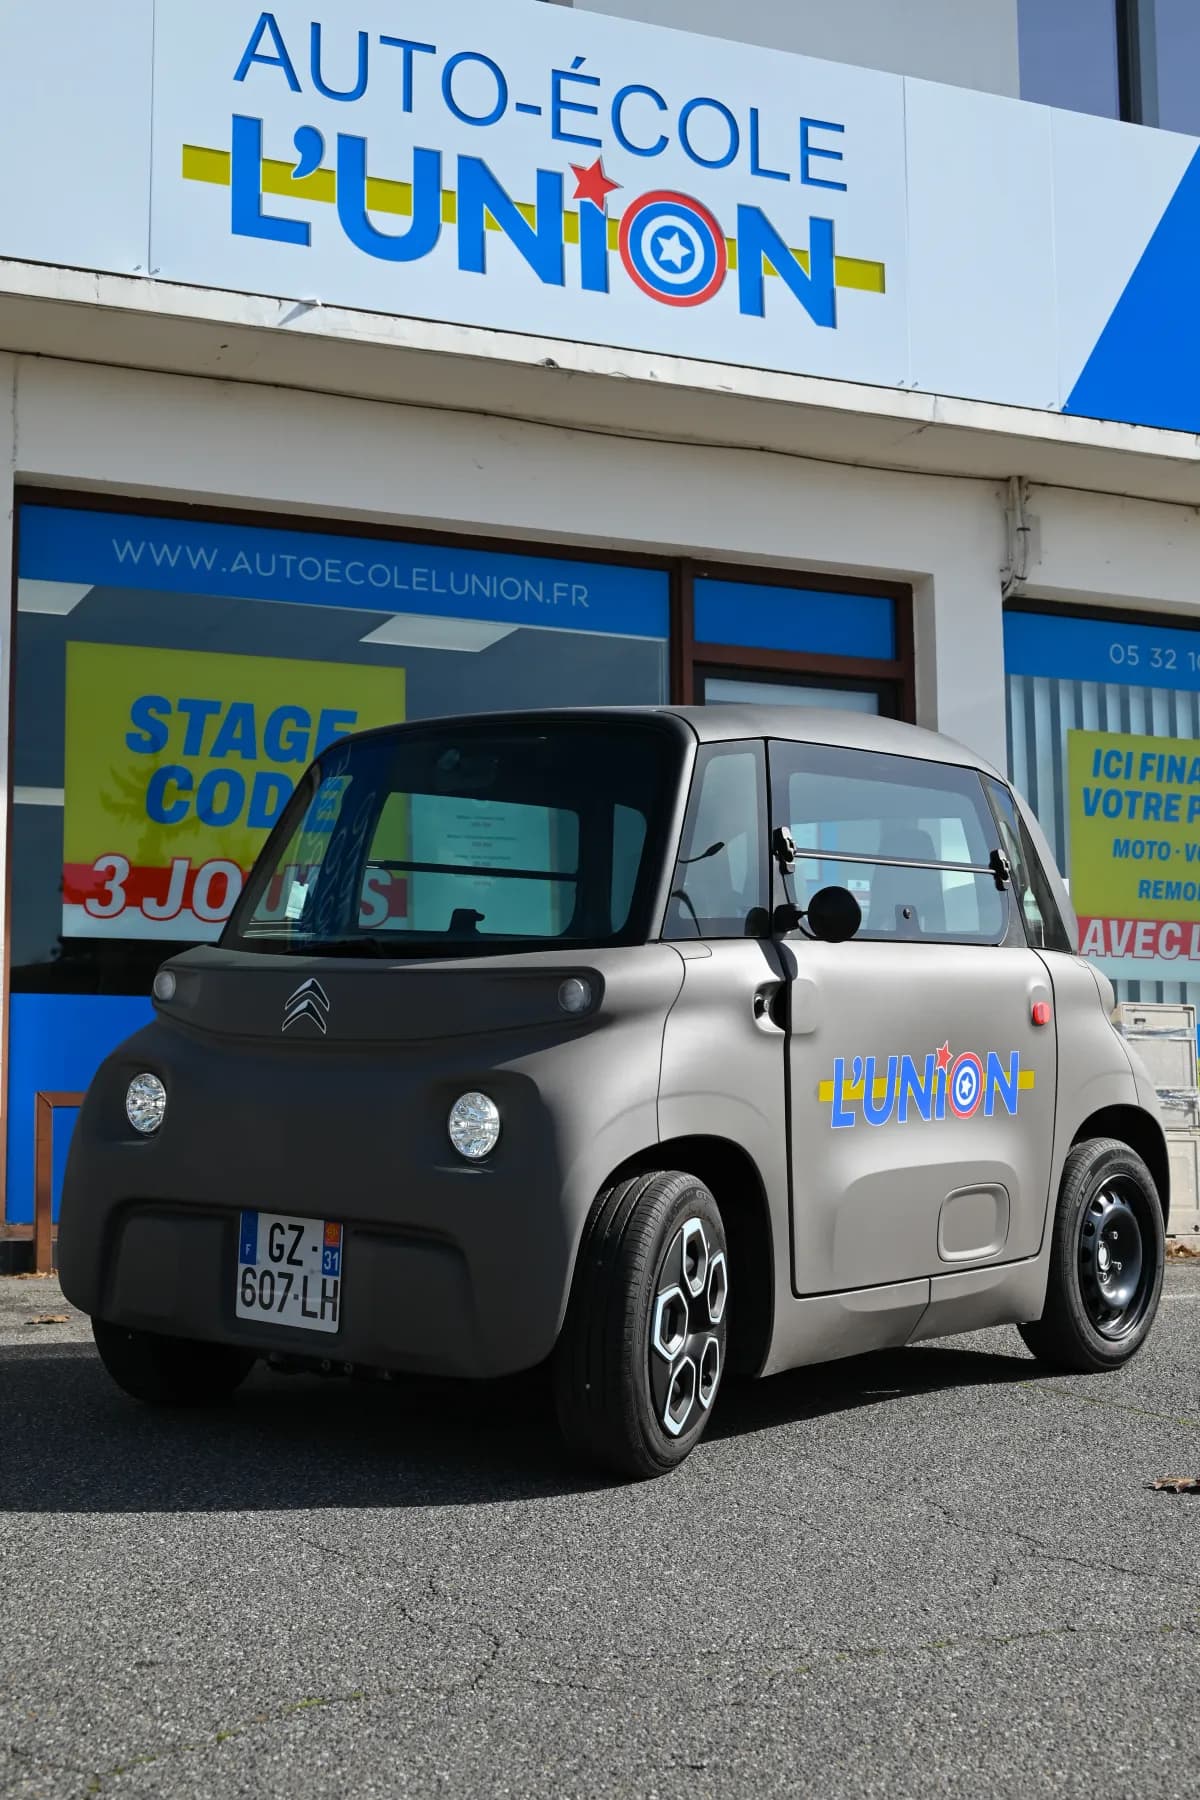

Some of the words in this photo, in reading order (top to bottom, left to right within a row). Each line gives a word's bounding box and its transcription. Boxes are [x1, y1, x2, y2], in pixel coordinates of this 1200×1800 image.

[233, 12, 847, 192] AUTO-ÉCOLE
[112, 538, 590, 608] WWW.AUTOECOLELUNION.FR
[1109, 643, 1139, 666] 05
[1149, 647, 1177, 670] 32
[126, 695, 357, 764] STAGE
[1092, 748, 1133, 780] ICI
[1082, 786, 1182, 823] VOTRE
[1112, 838, 1171, 861] MOTO
[83, 852, 130, 919] 3
[1080, 918, 1182, 960] AVEC
[245, 1243, 252, 1256] F
[324, 1250, 339, 1272] 31
